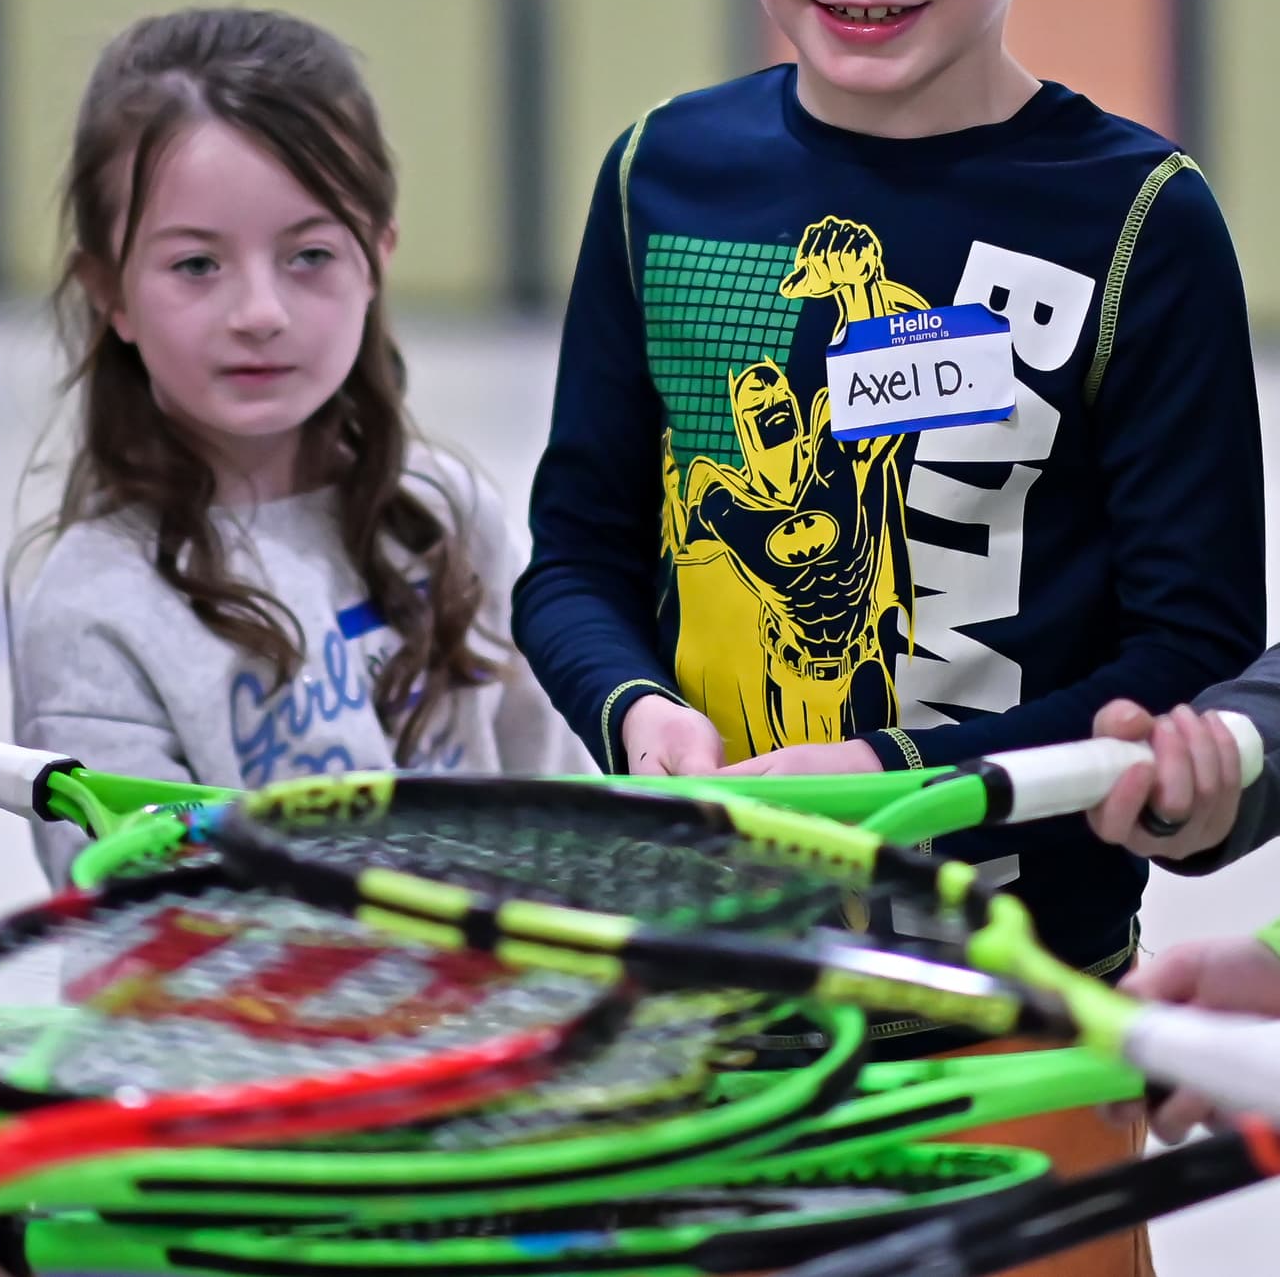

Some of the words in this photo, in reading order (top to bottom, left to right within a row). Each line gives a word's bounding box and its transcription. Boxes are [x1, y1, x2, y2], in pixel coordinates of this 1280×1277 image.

[889, 312, 943, 336] Hello
[891, 336, 907, 345] my
[909, 330, 938, 343] name
[940, 329, 950, 338] is
[848, 362, 921, 407] Axel
[934, 360, 974, 397] D.
